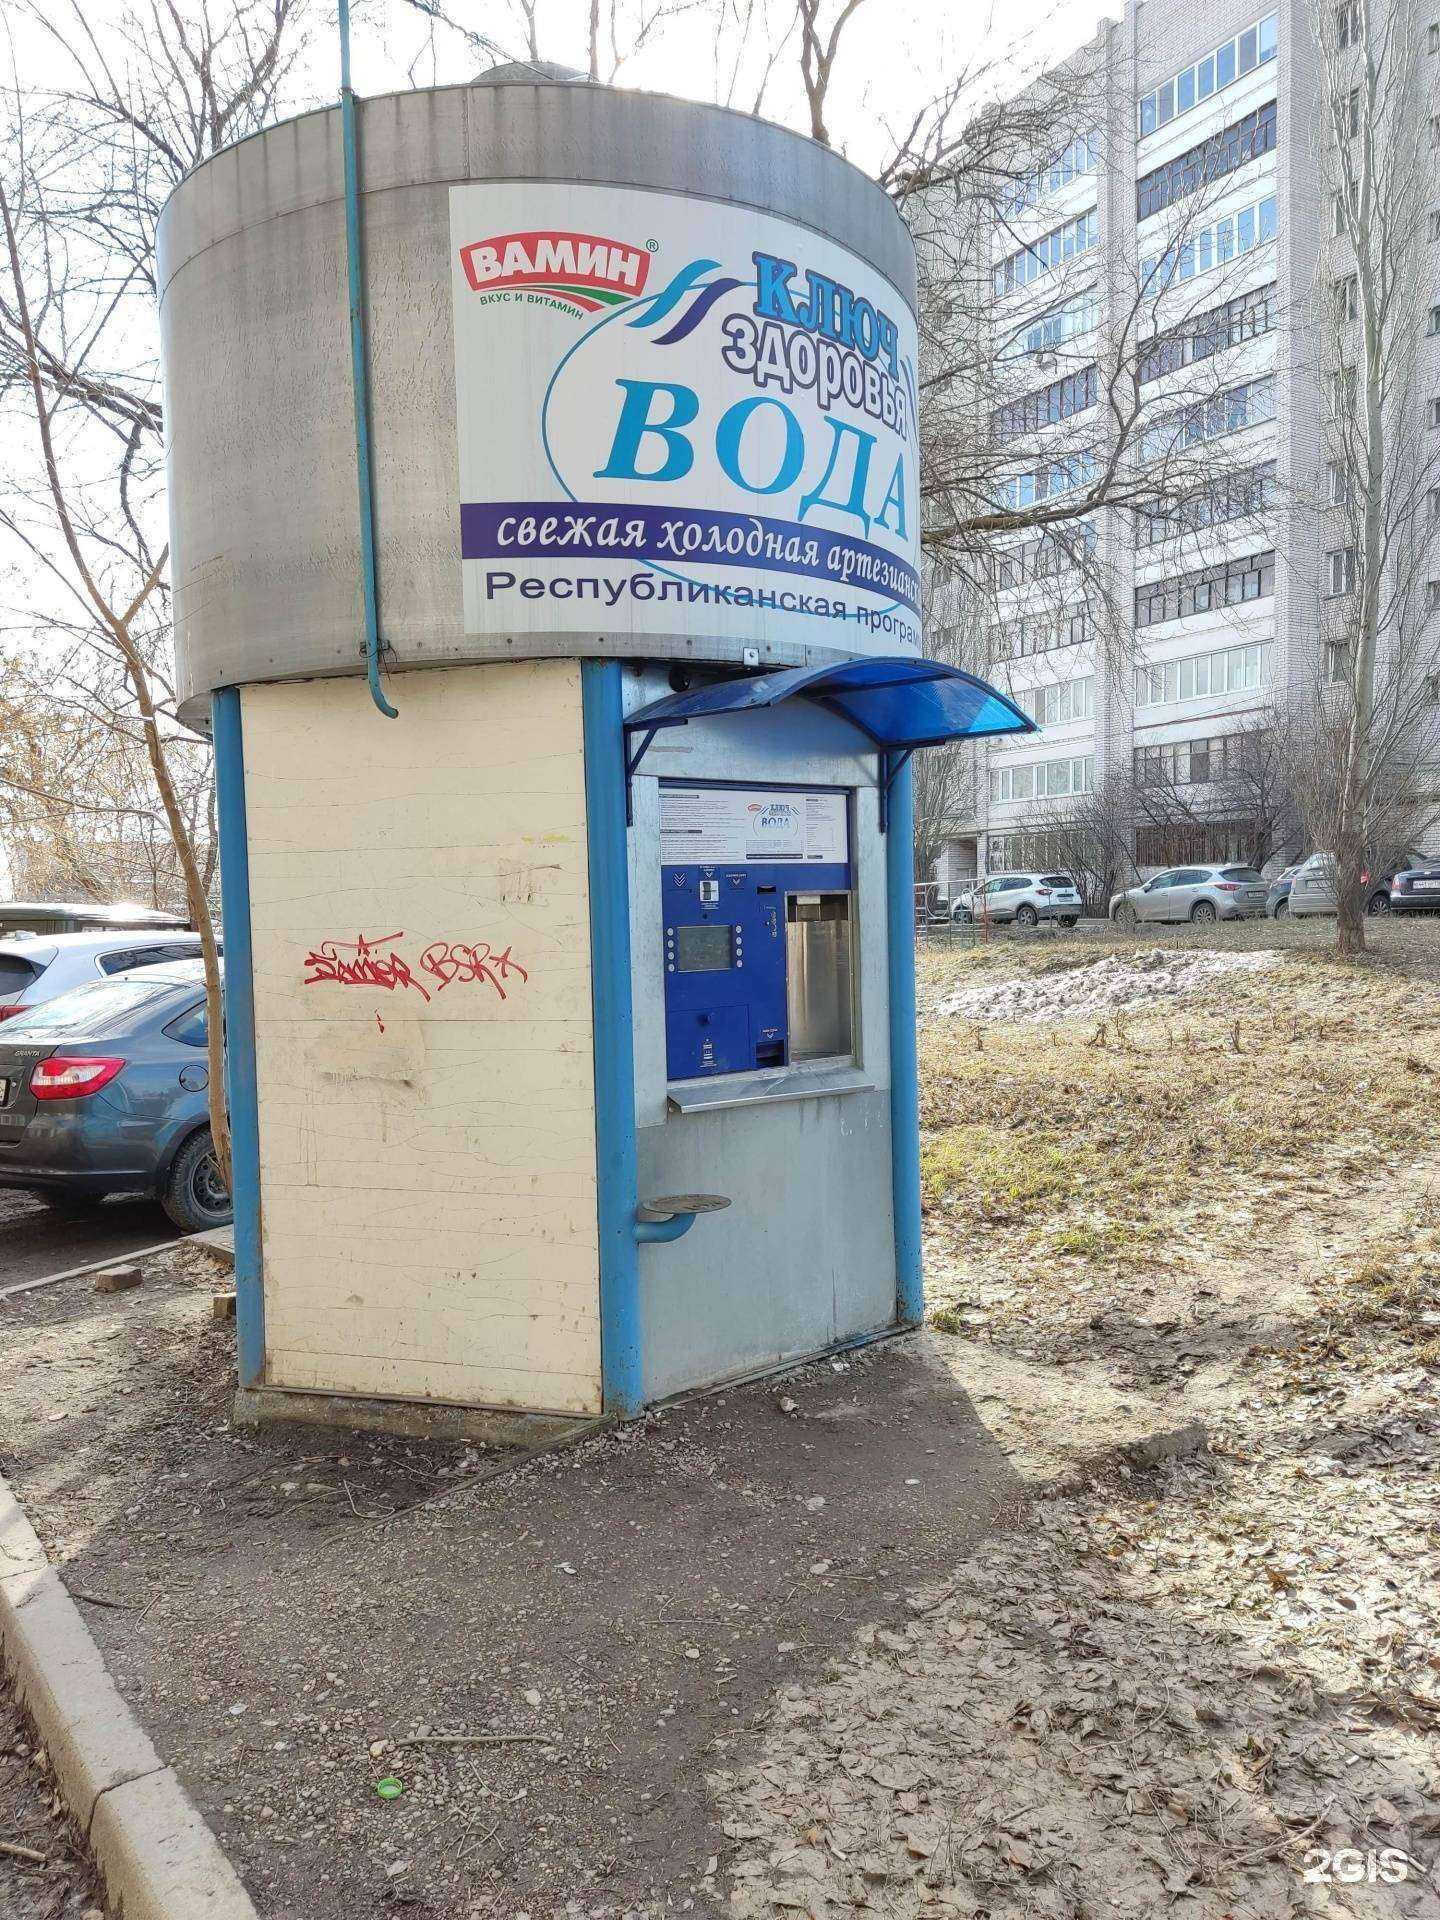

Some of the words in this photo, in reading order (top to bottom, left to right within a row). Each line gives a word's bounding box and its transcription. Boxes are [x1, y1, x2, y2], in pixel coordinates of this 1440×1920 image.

[470, 239, 641, 287] ВАМИН
[480, 292, 511, 306] ВКУС
[514, 292, 523, 302] И
[527, 293, 584, 321] ВИТАМИН
[751, 250, 900, 383] КЛЮЧ
[721, 312, 907, 442] ЗДОРОВЬЯ
[592, 378, 909, 542] ВОДА
[497, 515, 647, 548] свежая
[656, 517, 820, 567] холодная
[486, 571, 846, 622] Республиканская
